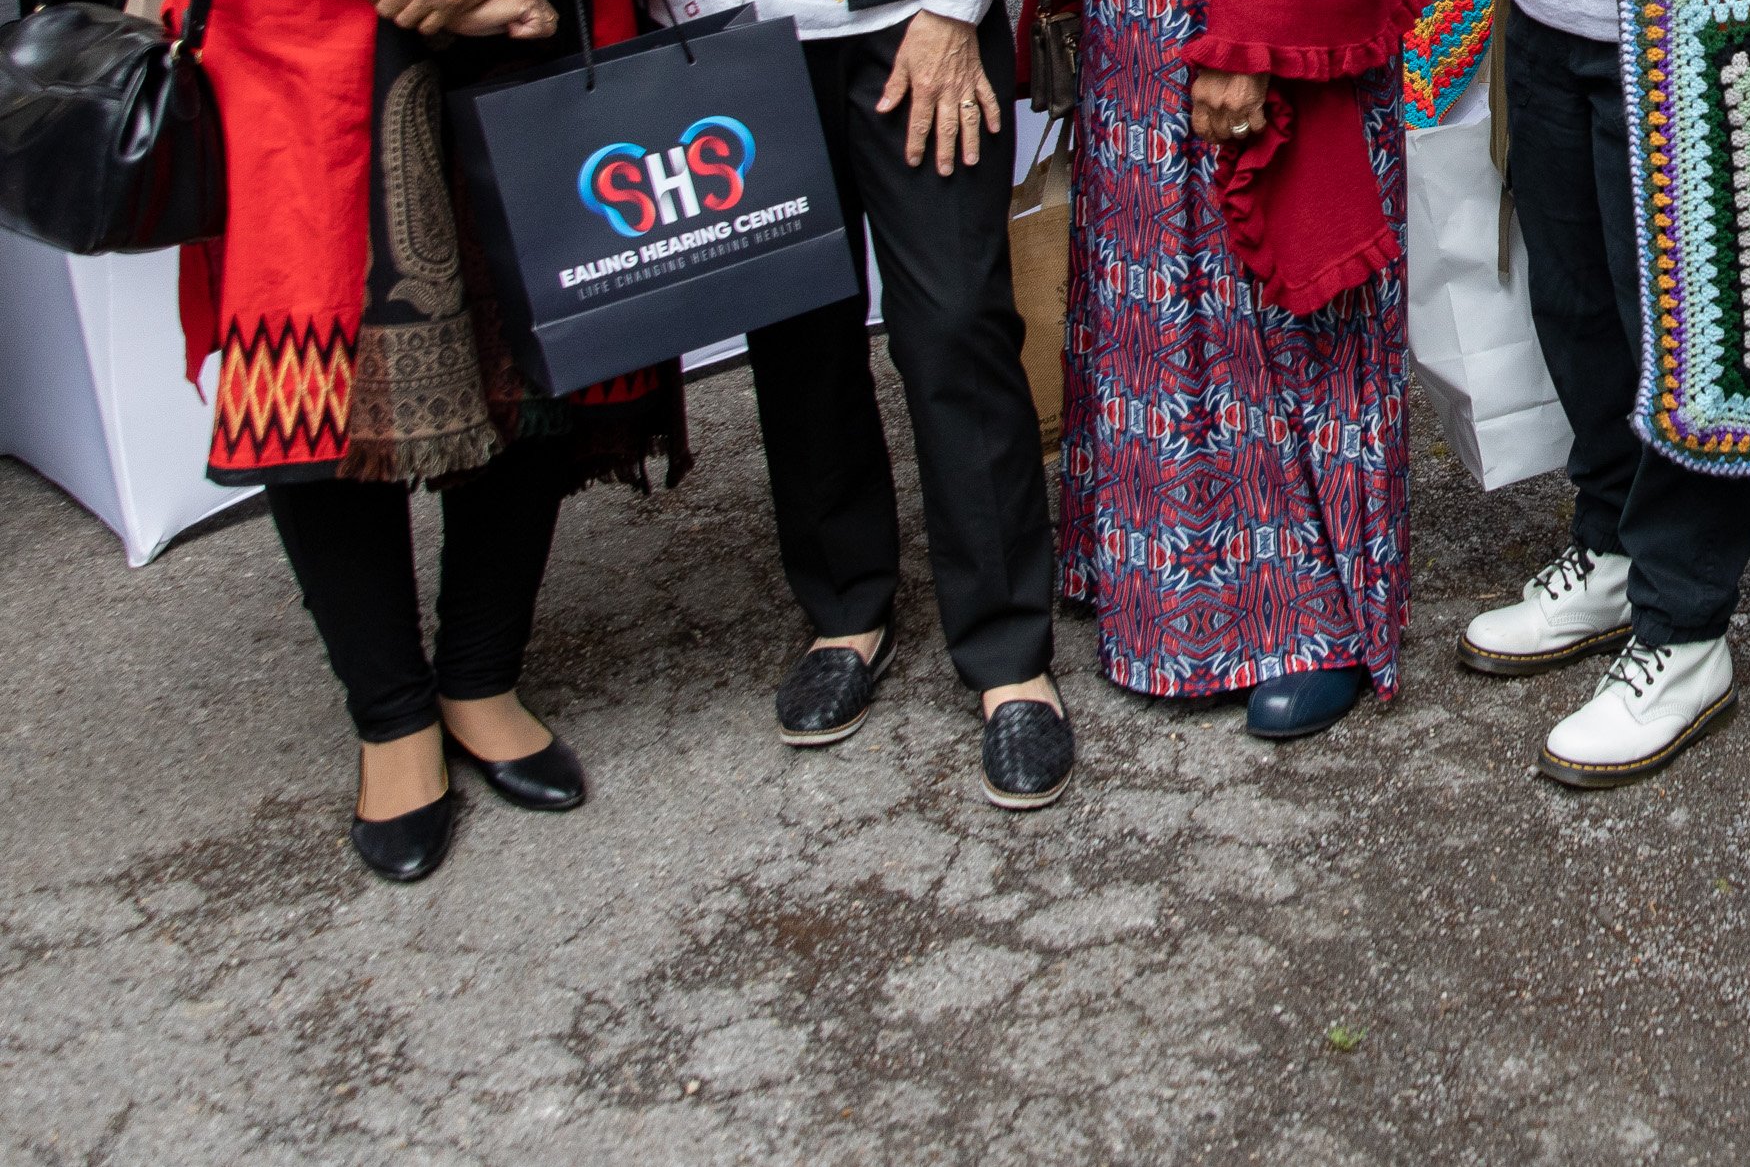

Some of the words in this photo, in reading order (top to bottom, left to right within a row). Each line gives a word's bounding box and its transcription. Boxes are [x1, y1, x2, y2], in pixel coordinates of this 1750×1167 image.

[596, 134, 745, 234] SHS
[558, 249, 639, 289] EALING
[638, 221, 732, 263] HEARING
[733, 196, 810, 234] CENTRE
[577, 279, 610, 301] LIFE
[615, 256, 686, 289] CHANGING
[691, 235, 750, 265] HEARING
[754, 219, 802, 245] HEALTH
